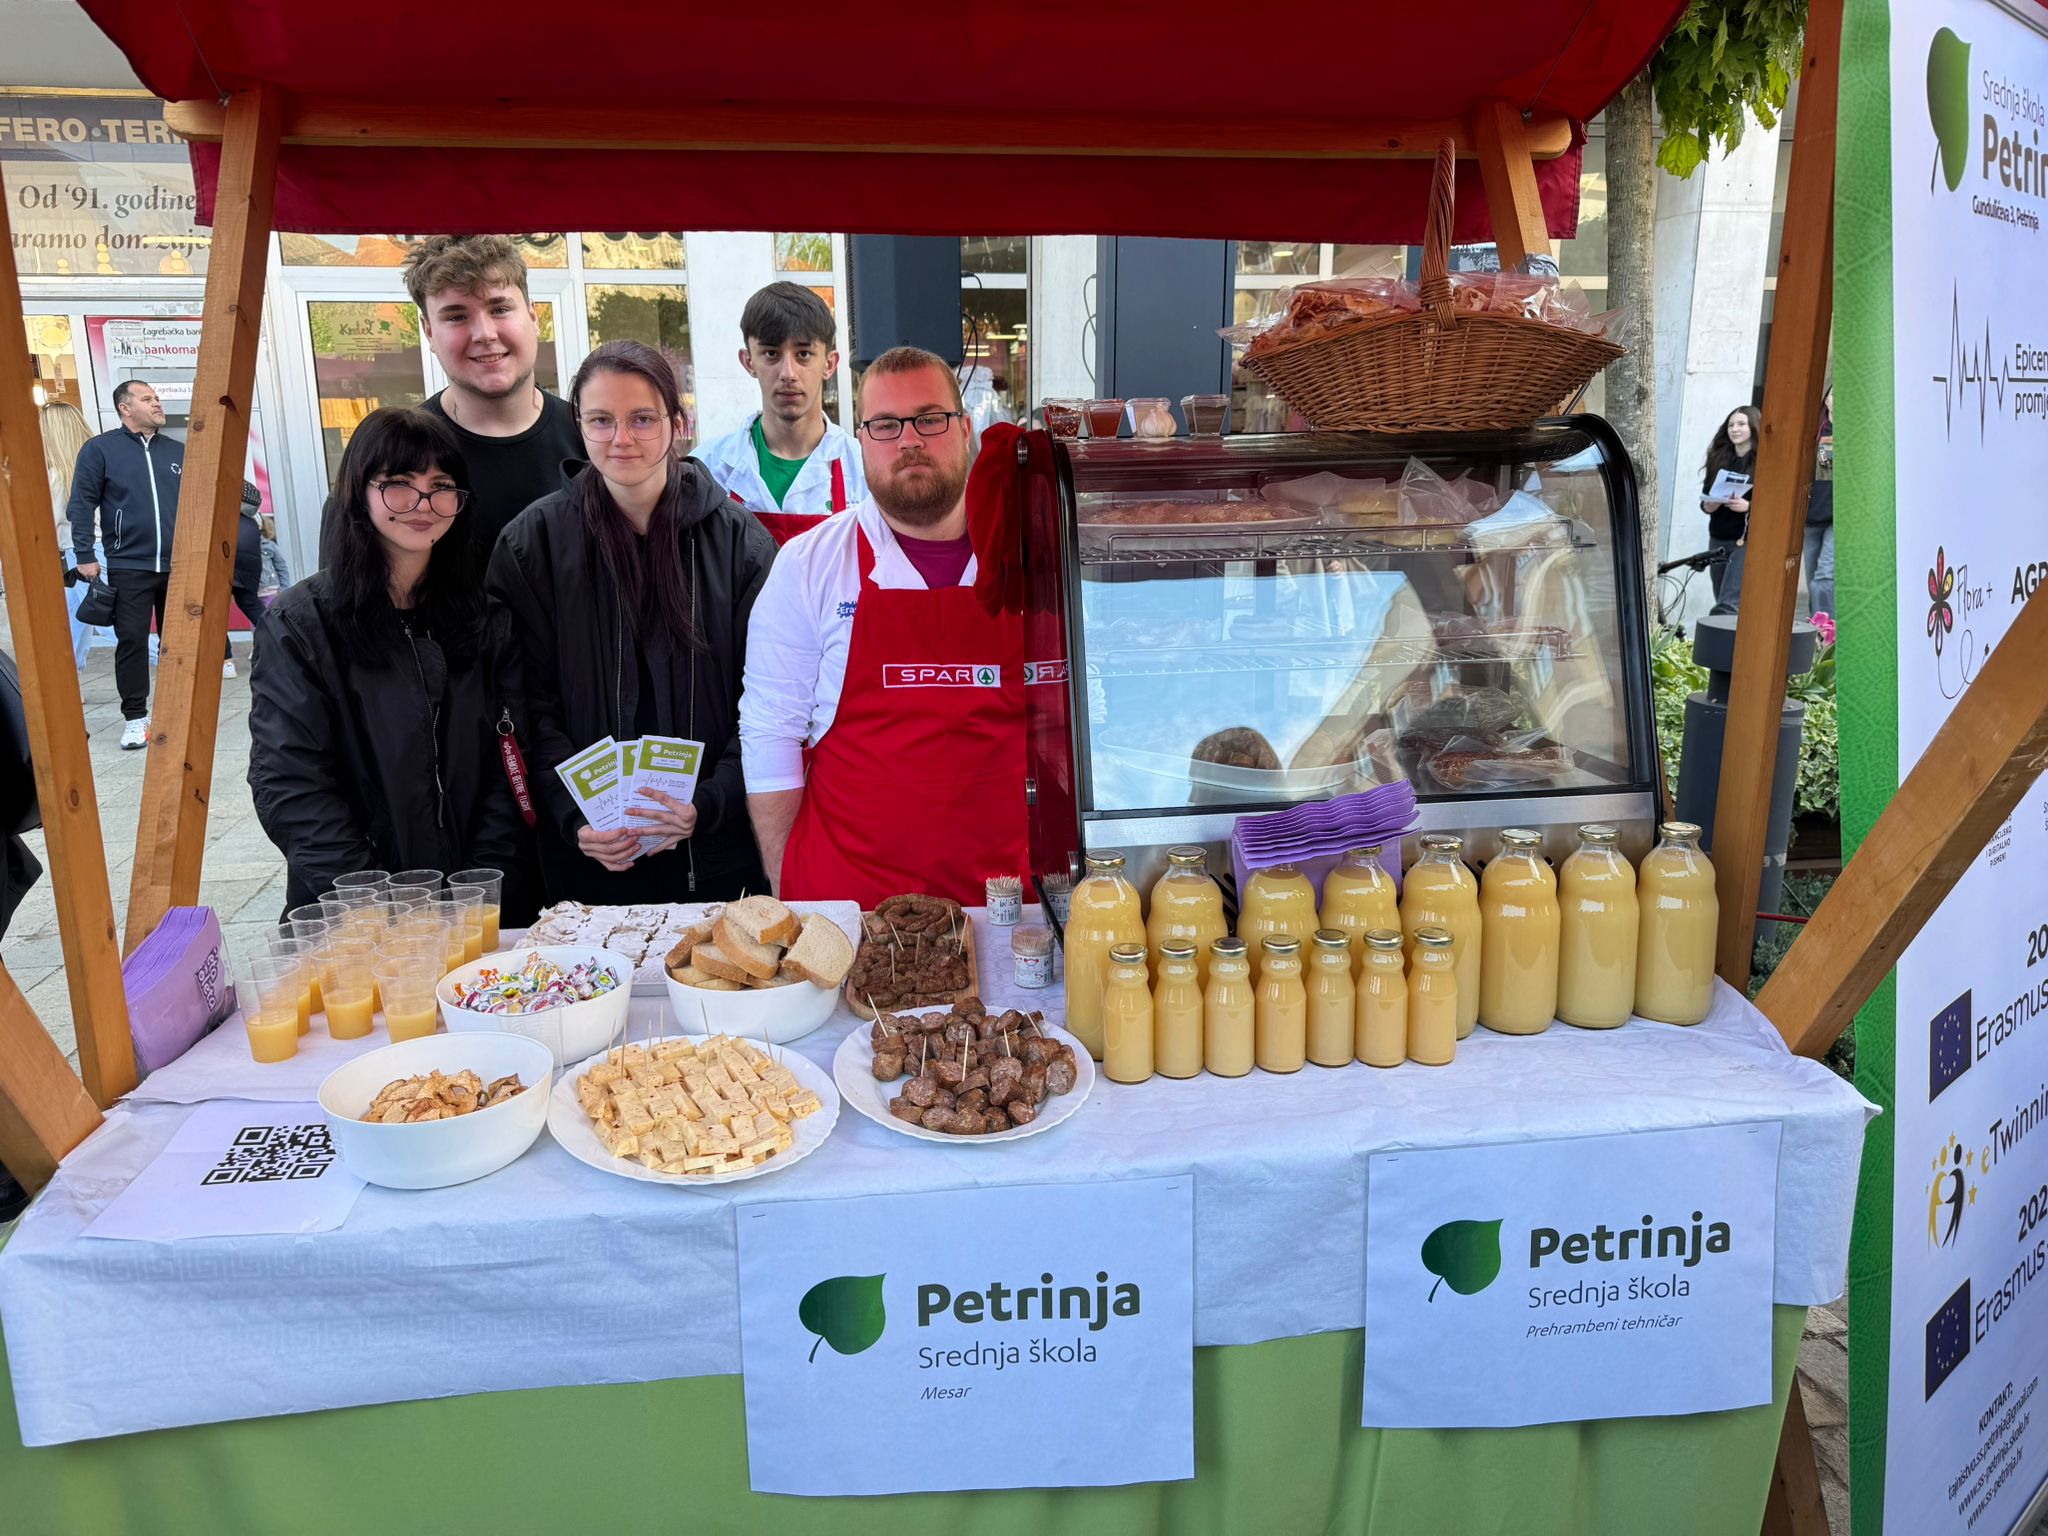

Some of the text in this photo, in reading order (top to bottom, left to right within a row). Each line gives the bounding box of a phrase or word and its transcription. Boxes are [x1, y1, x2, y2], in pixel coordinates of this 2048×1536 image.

[1982, 70, 2045, 127] Srednja škola
[19, 184, 57, 209] Od
[115, 184, 196, 218] godine
[95, 225, 149, 249] dom
[2016, 207, 2039, 234] Petrinja
[2015, 386, 2048, 421] promj
[900, 669, 971, 682] SPAR
[1976, 978, 2048, 1062] Erasmus
[1529, 1210, 1732, 1269] Petrinja
[917, 1270, 1141, 1332] Petrinja
[1528, 1273, 1691, 1308] Srednja škola
[1525, 1314, 1684, 1339] Prehrambeni tehničar
[918, 1337, 1097, 1371] Srednja škola
[920, 1384, 972, 1400] Mesar
[1979, 1381, 2014, 1436] KONTAKT:
